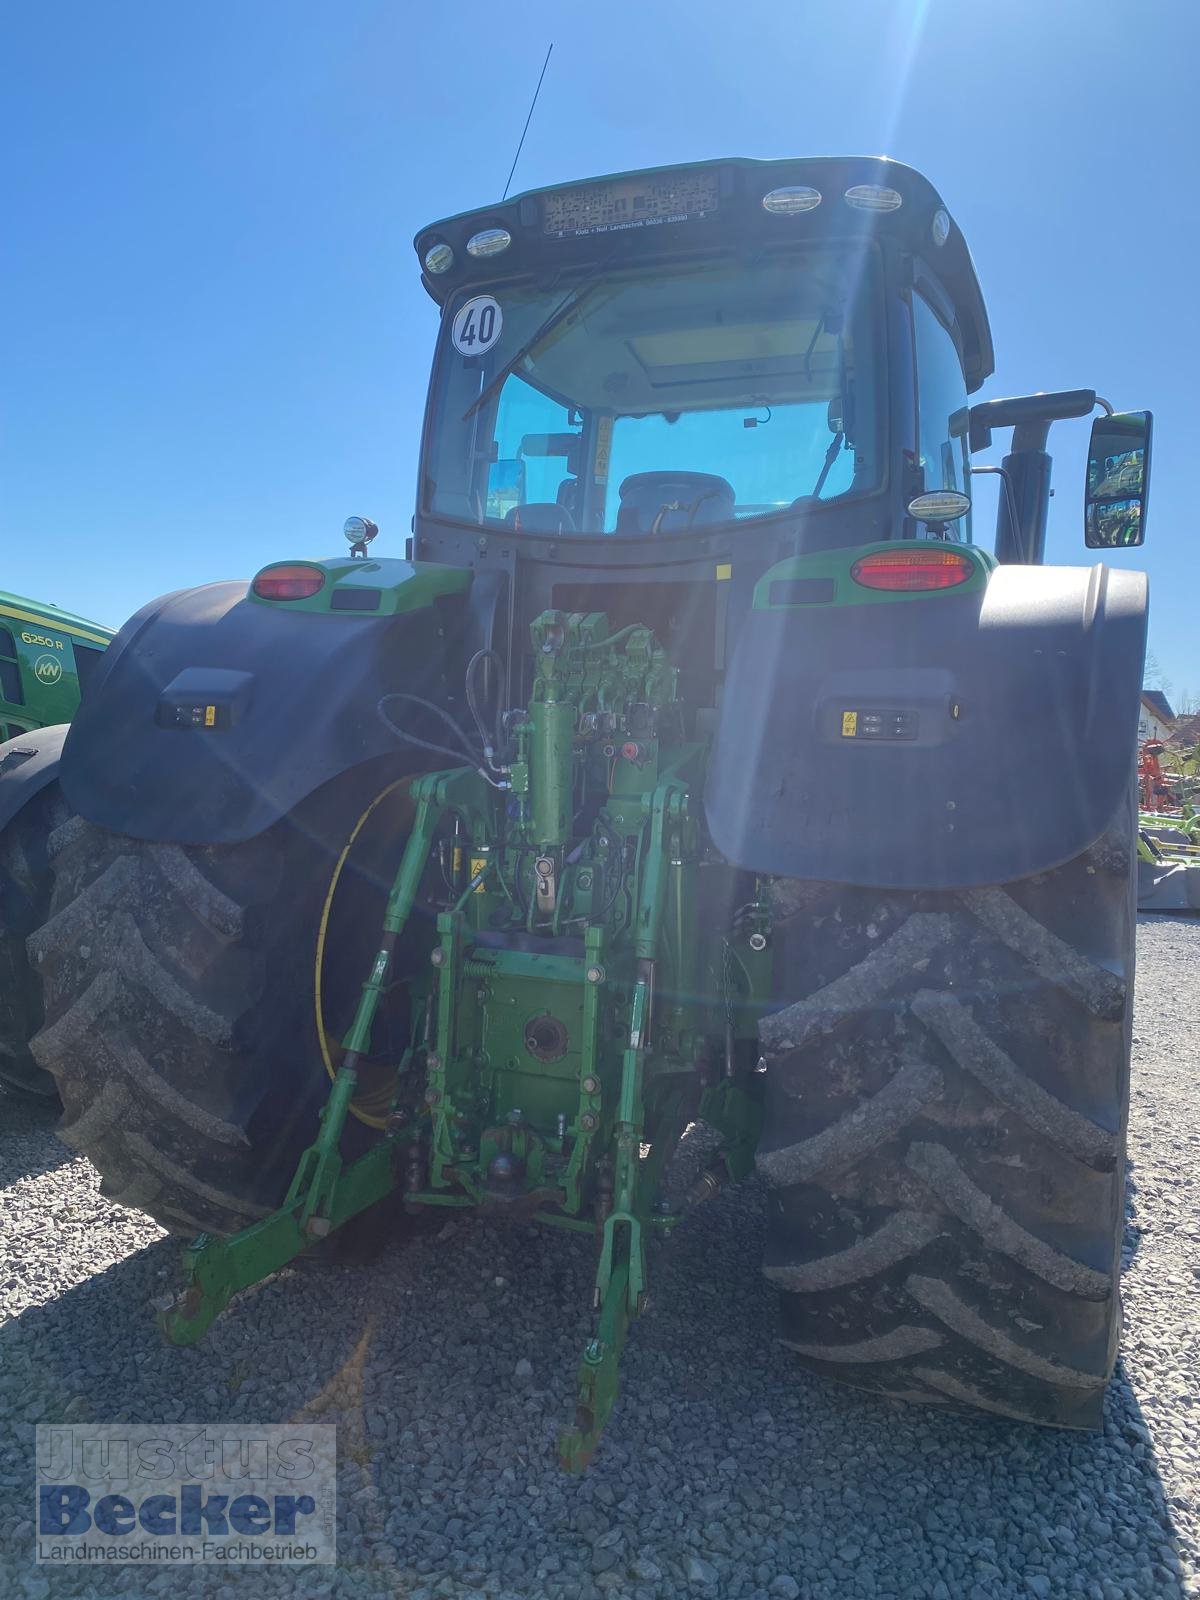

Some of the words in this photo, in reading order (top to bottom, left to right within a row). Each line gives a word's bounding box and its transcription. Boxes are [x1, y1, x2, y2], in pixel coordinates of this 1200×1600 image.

[610, 221, 643, 231] Landtechnik
[459, 305, 496, 346] 40
[21, 632, 54, 648] 6250
[55, 641, 64, 651] R
